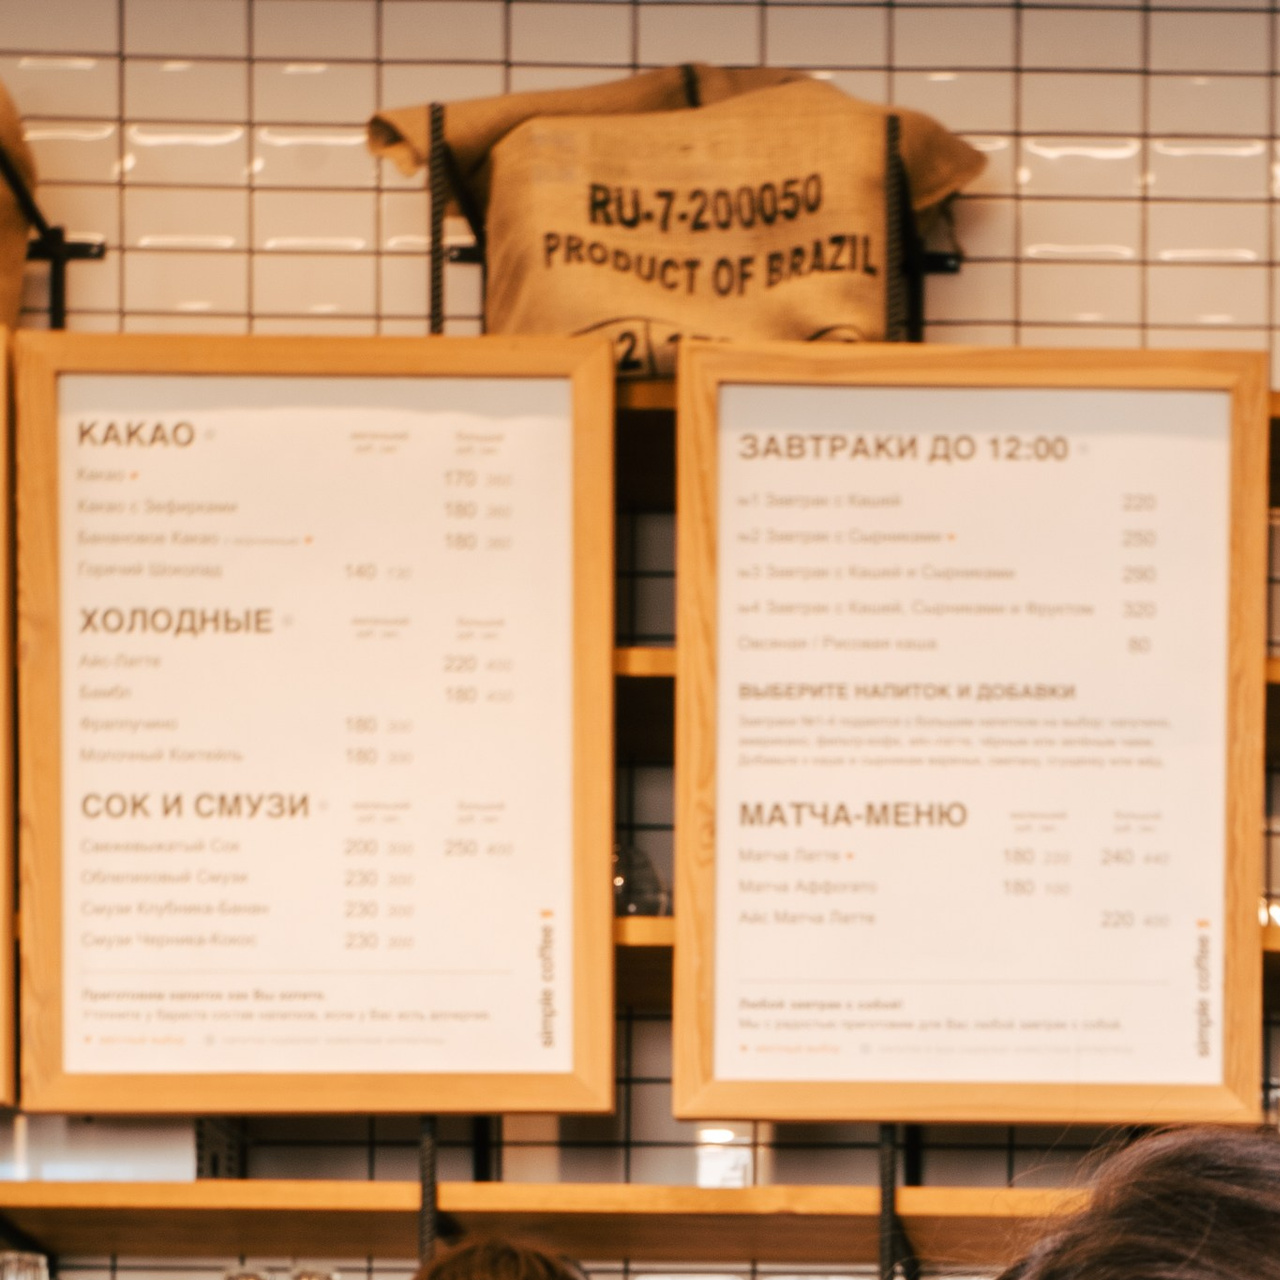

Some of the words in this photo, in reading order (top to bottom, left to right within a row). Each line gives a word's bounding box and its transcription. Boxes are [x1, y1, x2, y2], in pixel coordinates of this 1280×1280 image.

[588, 173, 823, 232] RU-7-200050
[543, 231, 701, 295] PRODUCT
[711, 256, 755, 297] OF
[765, 234, 877, 288] BRAZIL
[77, 420, 195, 448] КАКАО
[739, 435, 918, 461] ЗАВТРАКИ
[927, 435, 976, 464] ДО
[989, 437, 1069, 461] 12:00
[79, 607, 272, 637] ХОЛОДНЫЕ
[739, 684, 848, 701] ВЫБЕРИТЕ
[855, 684, 951, 701] НАПИТОК
[957, 684, 972, 700] И
[978, 684, 1076, 703] ДОБАВКИ
[81, 793, 149, 819] СОК
[162, 793, 184, 818] И
[195, 793, 310, 819] СМУЗИ
[739, 802, 967, 828] МАТЧА-МЕНЮ
